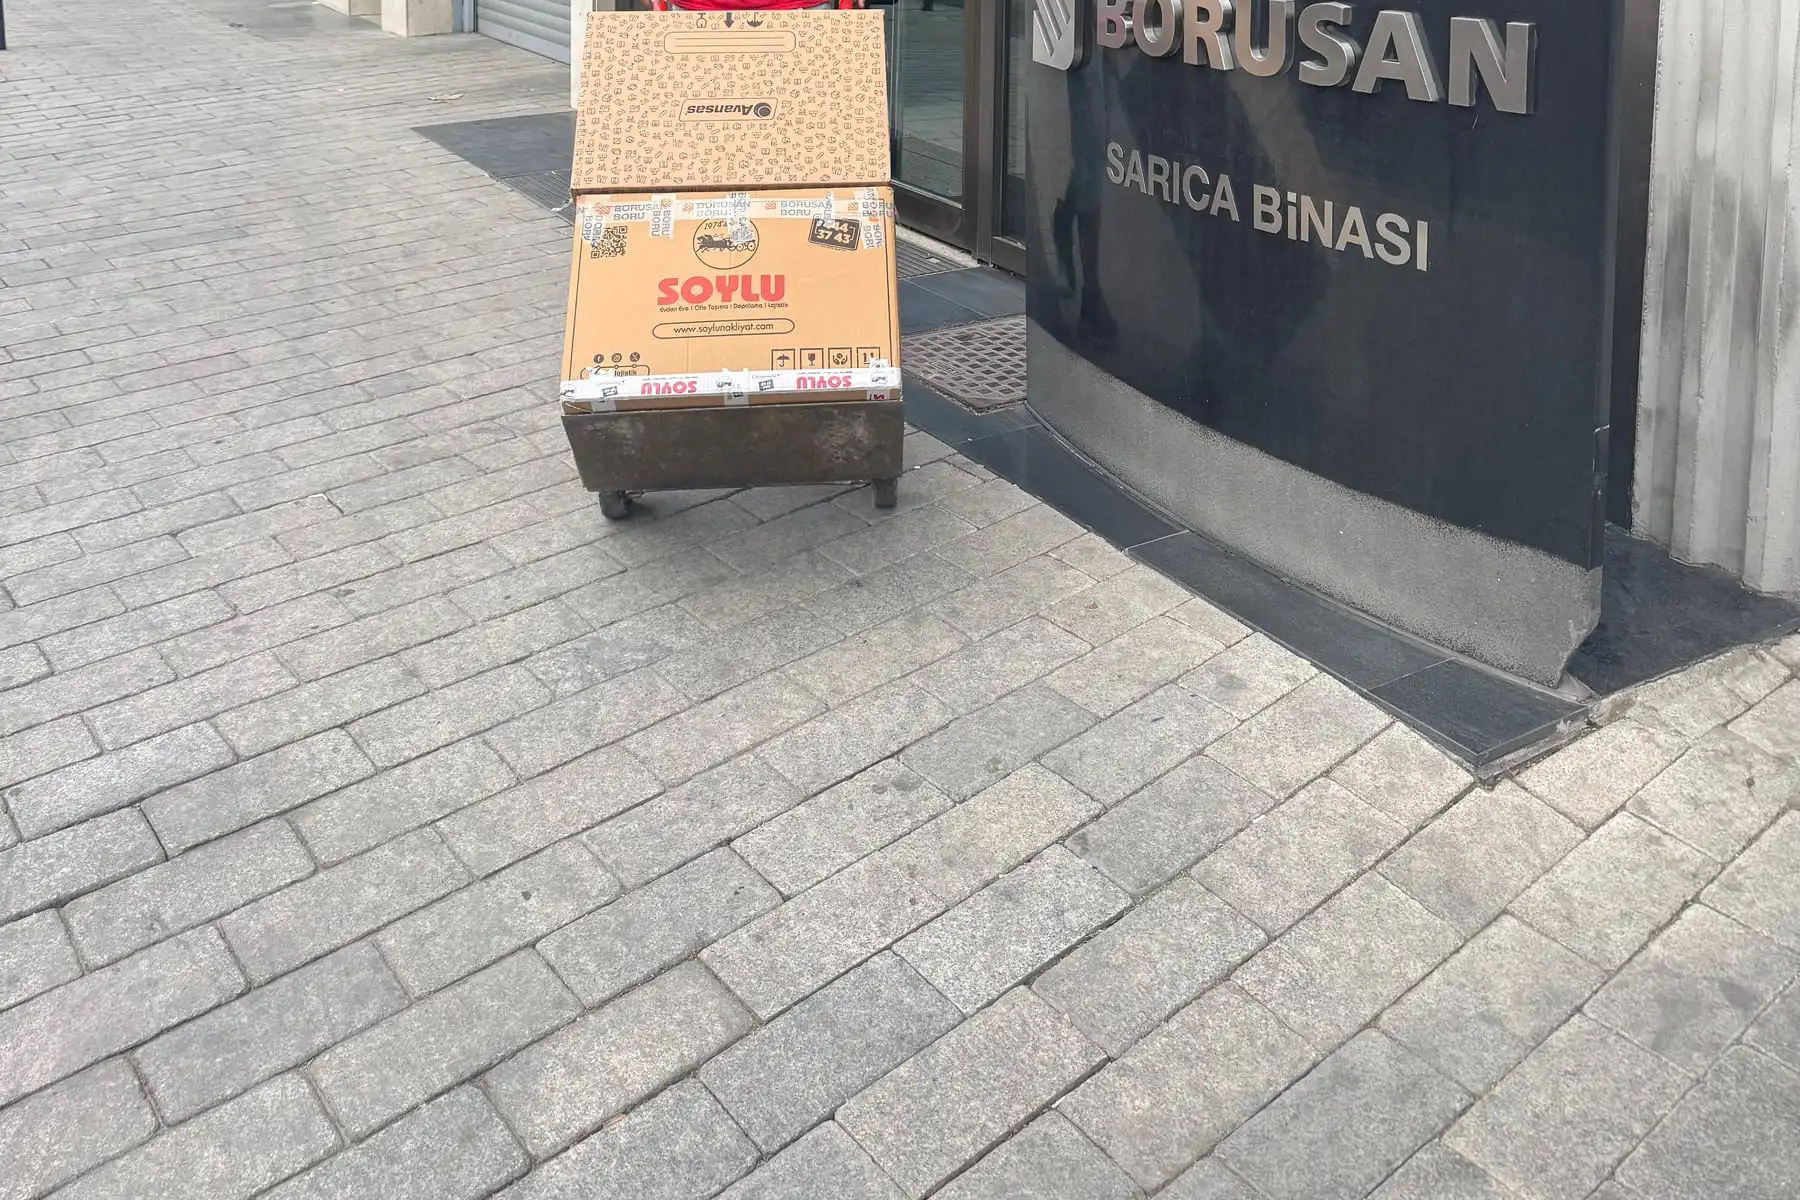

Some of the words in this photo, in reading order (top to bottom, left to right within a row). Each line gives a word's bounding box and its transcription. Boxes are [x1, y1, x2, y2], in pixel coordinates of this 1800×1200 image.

[687, 104, 753, 116] Avansas
[1106, 141, 1240, 222] SARICA
[613, 212, 646, 221] BORU
[816, 228, 833, 240] 37
[833, 232, 851, 244] 43
[657, 274, 786, 306] SOYLU
[673, 322, 774, 335] www.soylunakliyat.com
[640, 380, 698, 395] SOYLU
[796, 375, 853, 389] SOYLU
